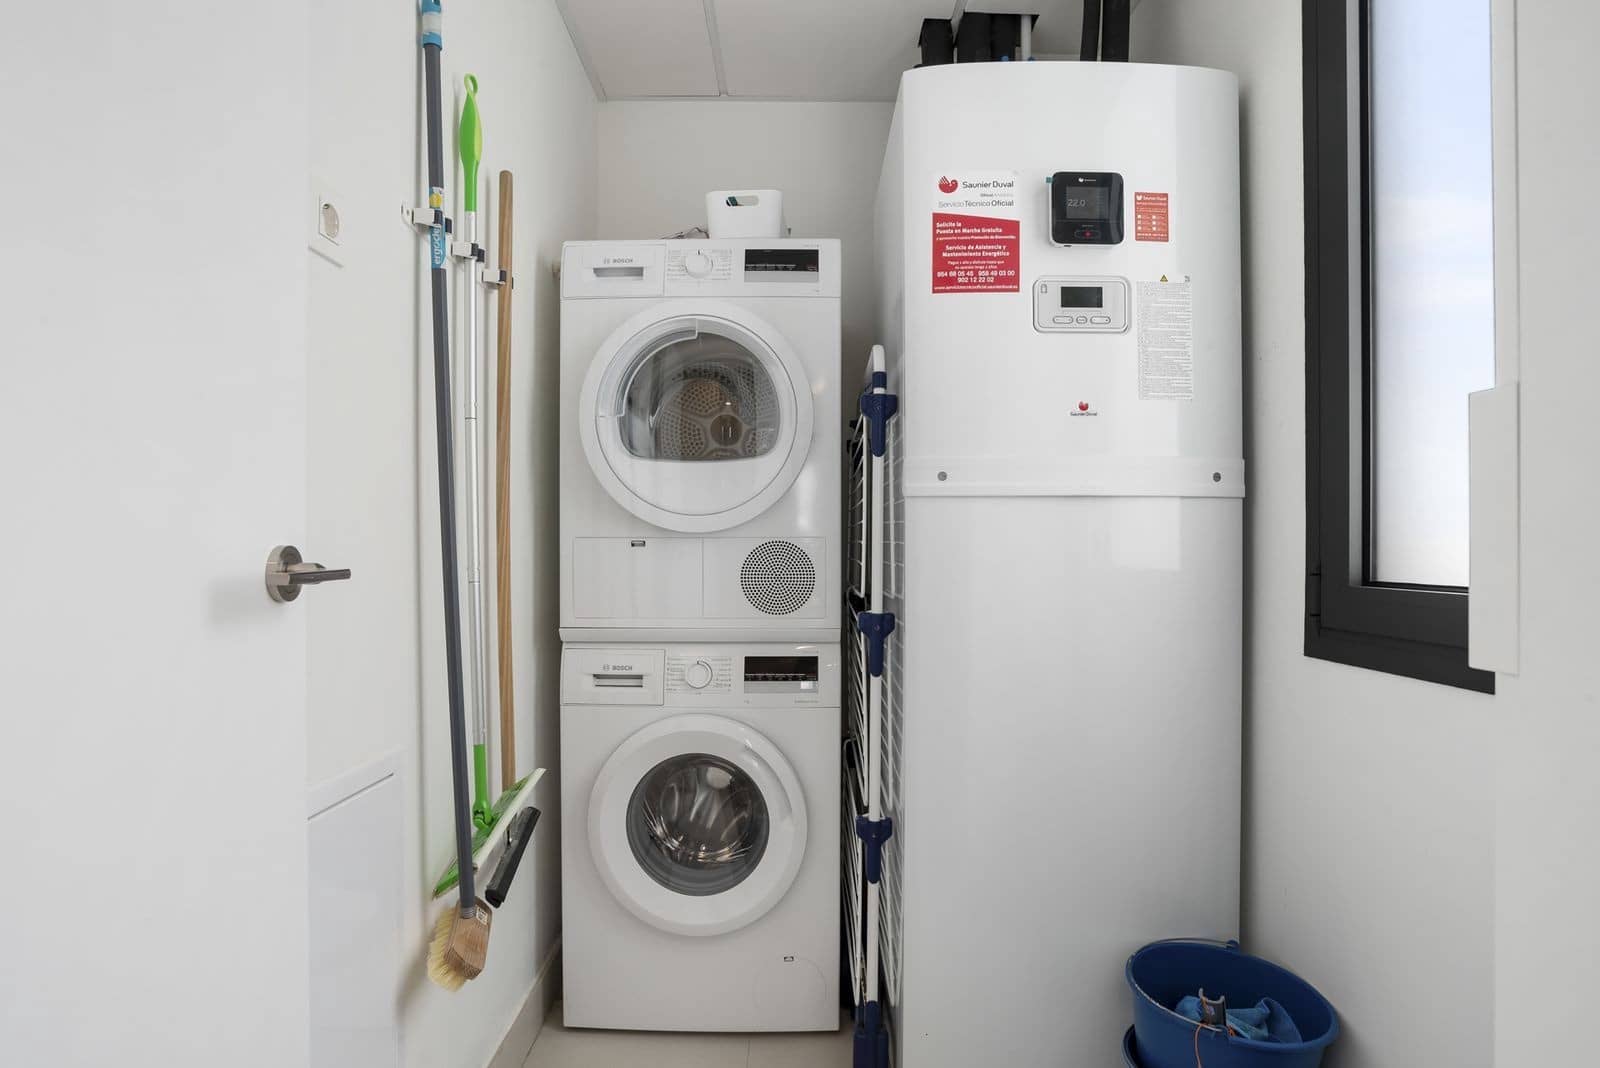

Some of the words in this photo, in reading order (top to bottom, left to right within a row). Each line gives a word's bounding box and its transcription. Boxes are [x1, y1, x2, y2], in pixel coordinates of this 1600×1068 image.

[962, 181, 992, 190] Saunier
[992, 180, 1014, 189] Duval
[938, 200, 965, 209] Servicio
[991, 199, 1014, 208] Oficial
[974, 243, 1002, 251] Asistencia
[982, 250, 1010, 258] Energético
